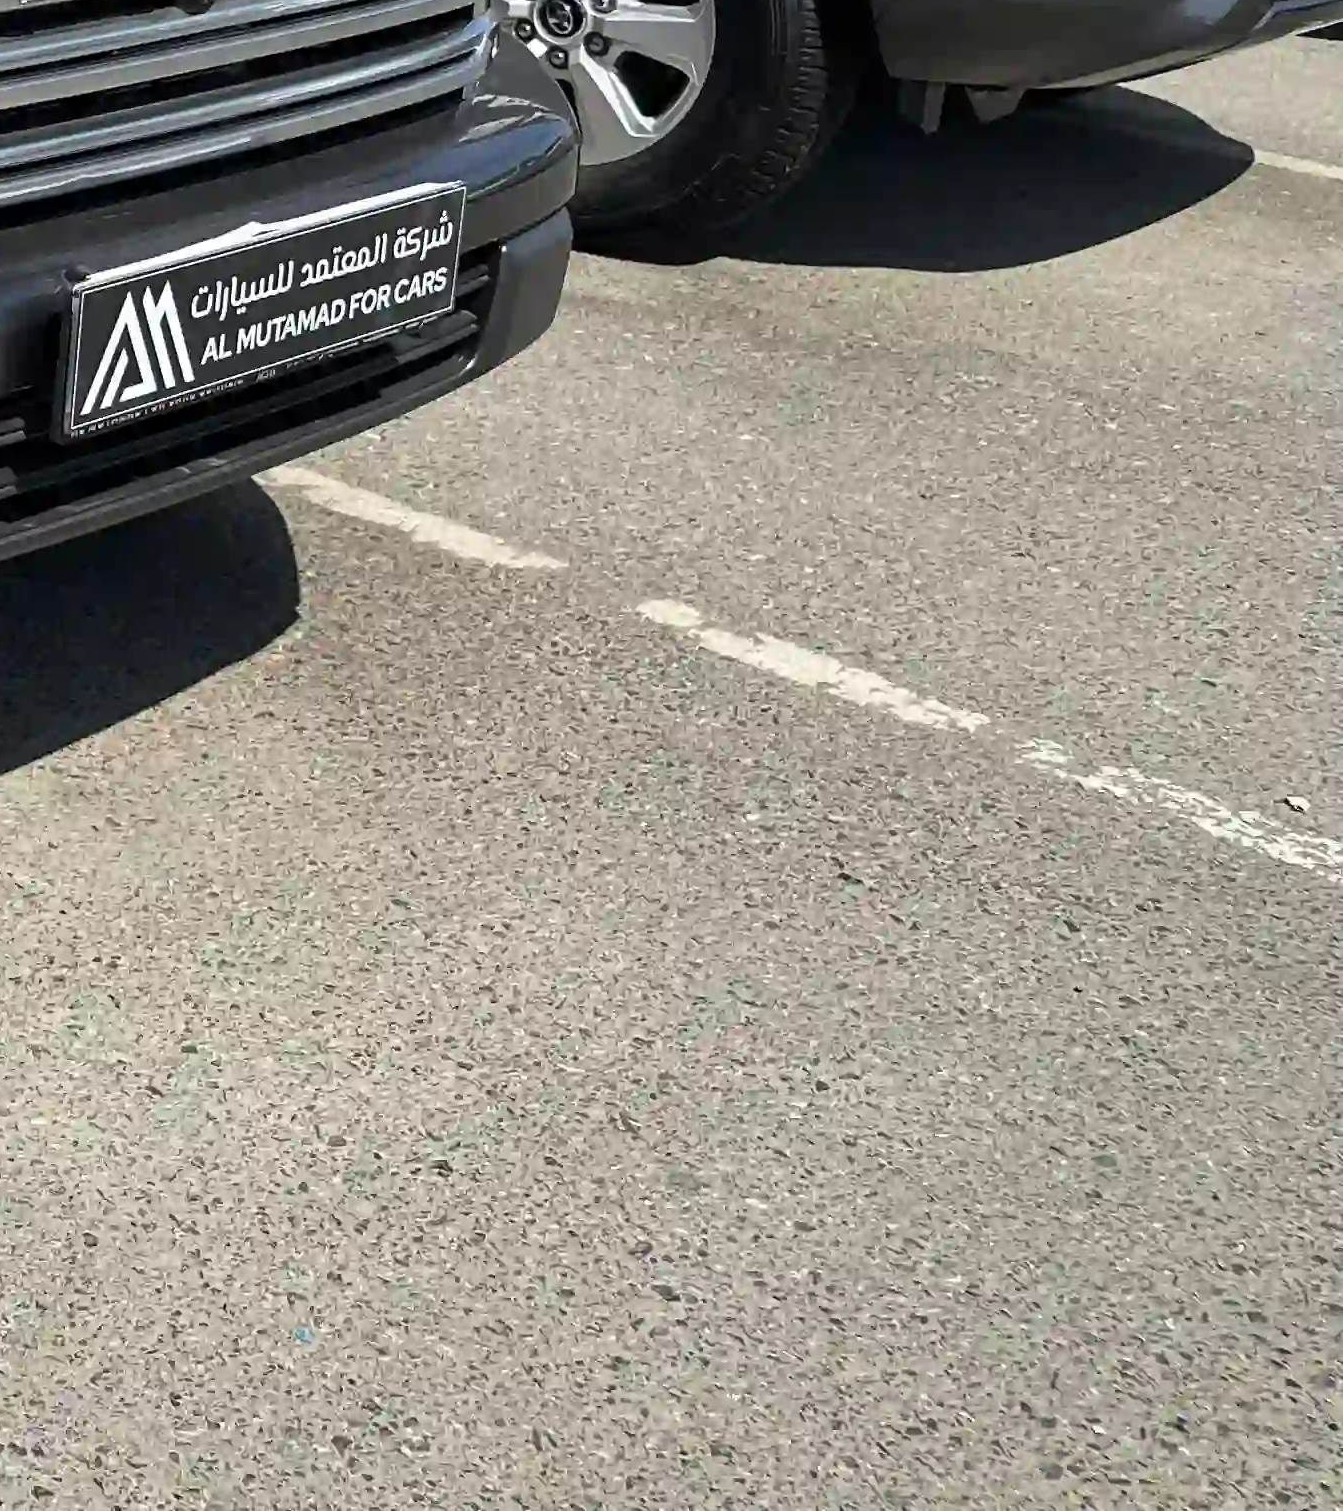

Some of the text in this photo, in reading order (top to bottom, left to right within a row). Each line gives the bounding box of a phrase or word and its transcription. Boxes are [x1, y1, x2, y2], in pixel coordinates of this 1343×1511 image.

[191, 210, 453, 321] شركة المعتمد للسيارات
[200, 266, 448, 366] AL MUTAMAD FOR CARS
